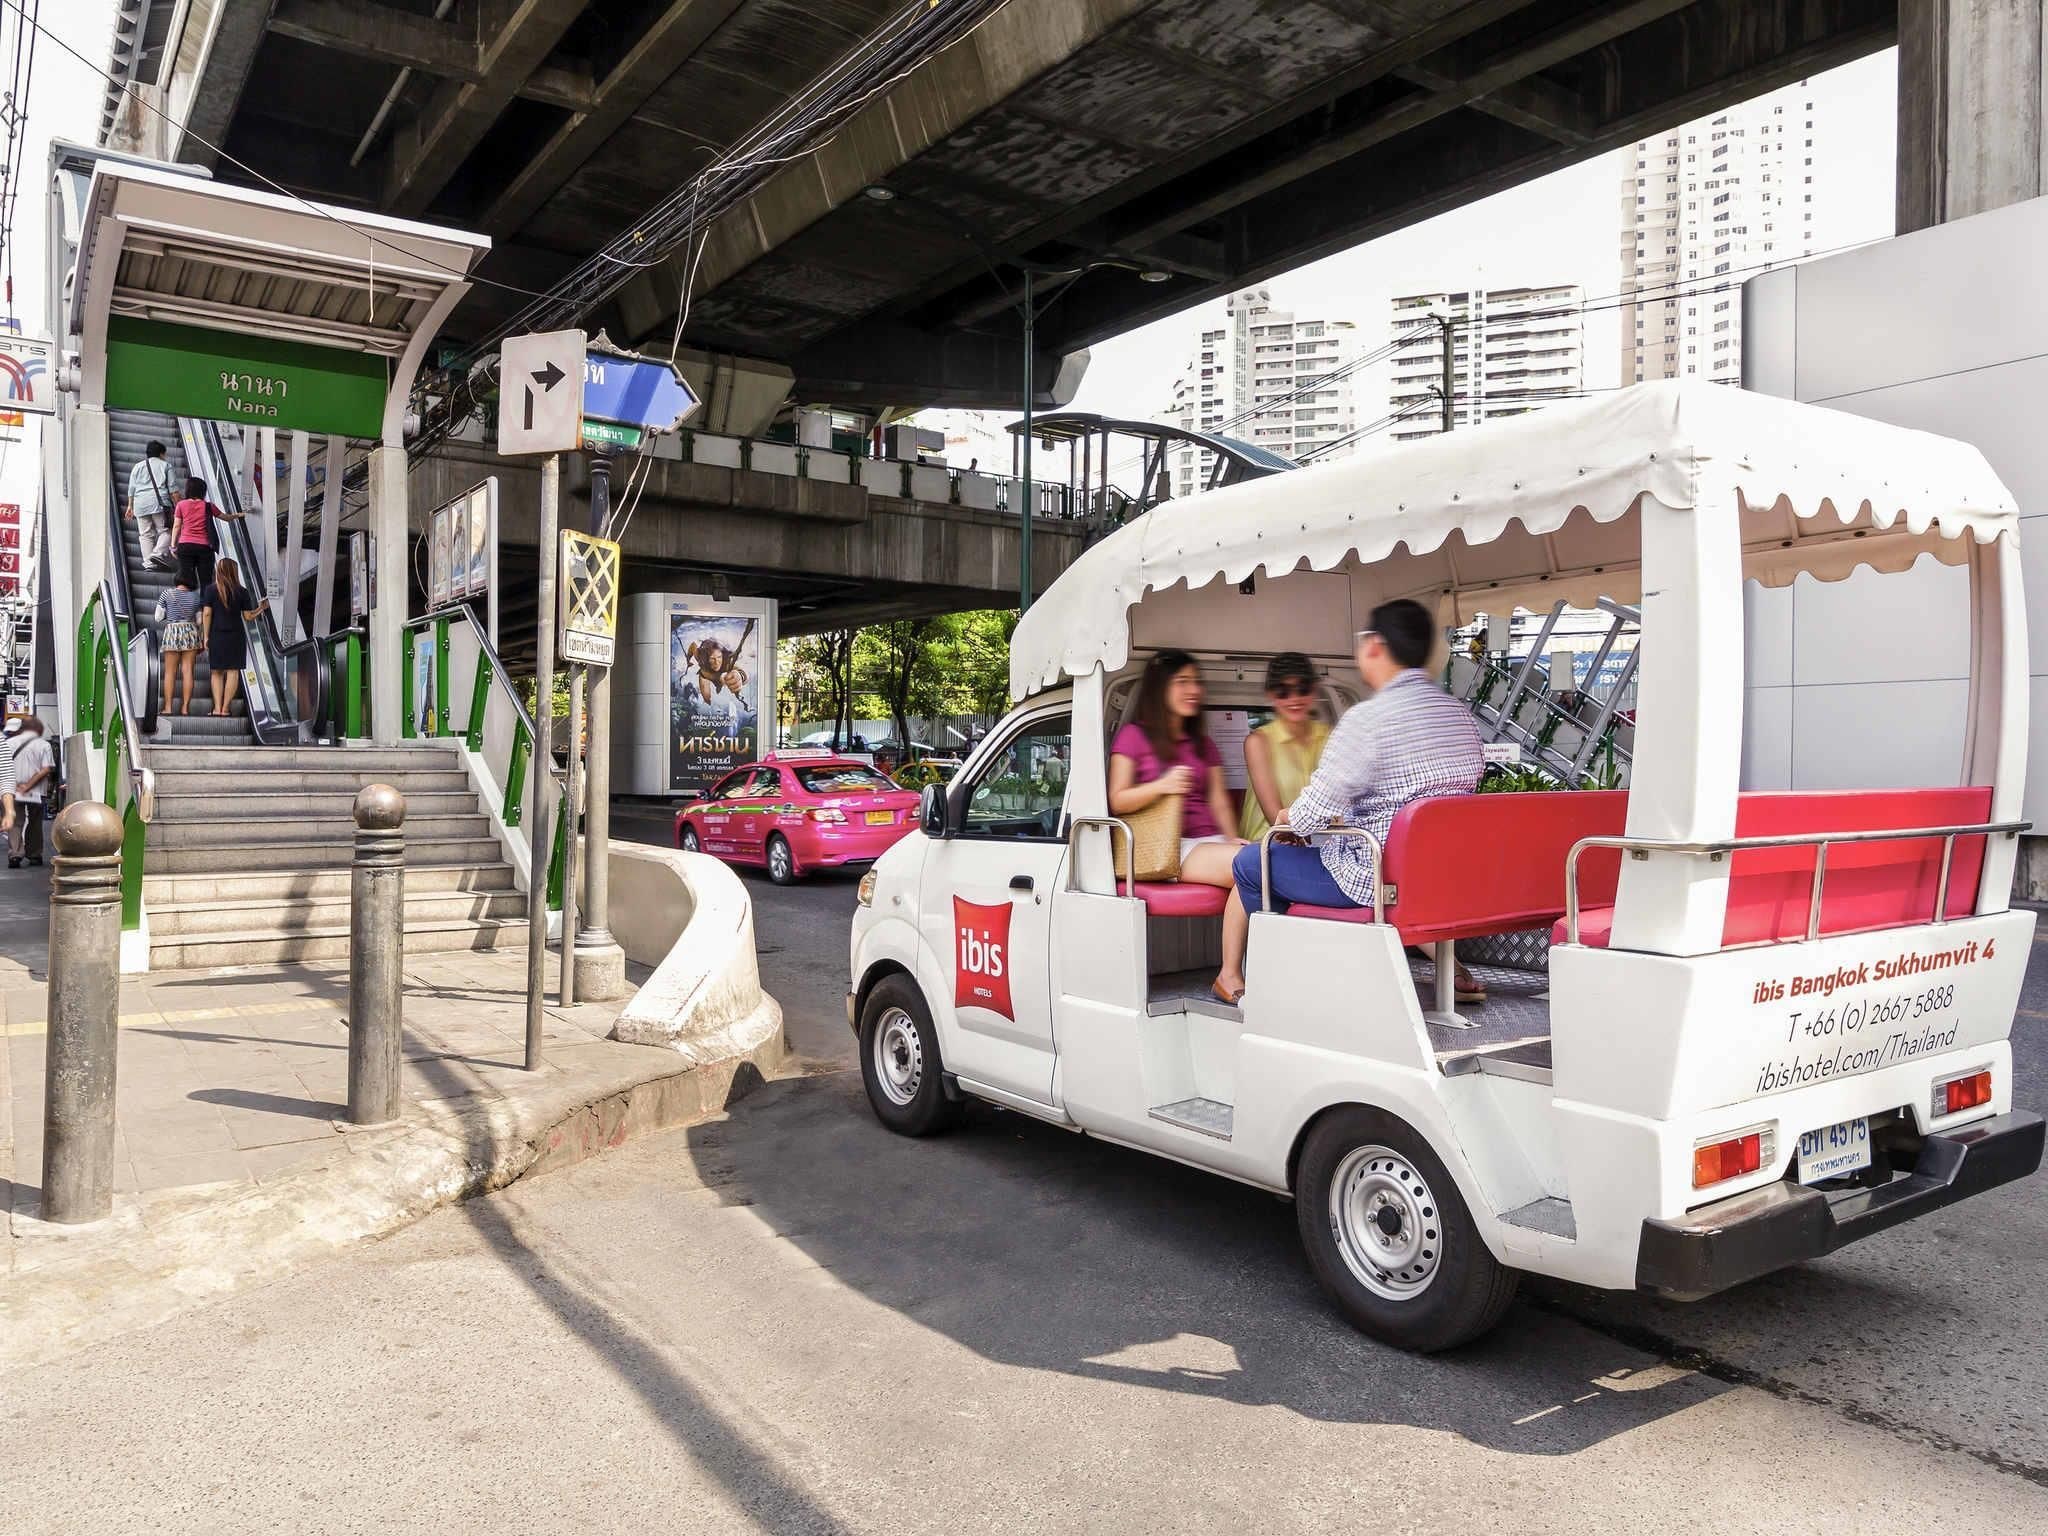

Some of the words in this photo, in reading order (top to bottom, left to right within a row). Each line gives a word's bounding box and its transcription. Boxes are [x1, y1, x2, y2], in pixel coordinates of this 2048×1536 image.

[0, 341, 46, 355] BTS
[220, 372, 288, 397] นานา
[228, 397, 278, 416] Nana
[961, 927, 1003, 977] ibis
[1753, 982, 1785, 1004] ibis
[1790, 962, 1869, 997] Bangkok
[1873, 940, 1978, 981] Sukhumvit
[1982, 938, 1996, 960] 4
[973, 986, 992, 998] HOTELS
[1788, 1012, 1802, 1042] T
[1804, 1009, 1835, 1037] +66
[1870, 996, 1911, 1025] 2667
[1913, 984, 1954, 1018] 5888
[1756, 1018, 1959, 1092] ibishotel.com/Thailand
[1829, 1119, 1866, 1149] 4575
[1811, 1152, 1861, 1177] กรุงเทพมหานคร
